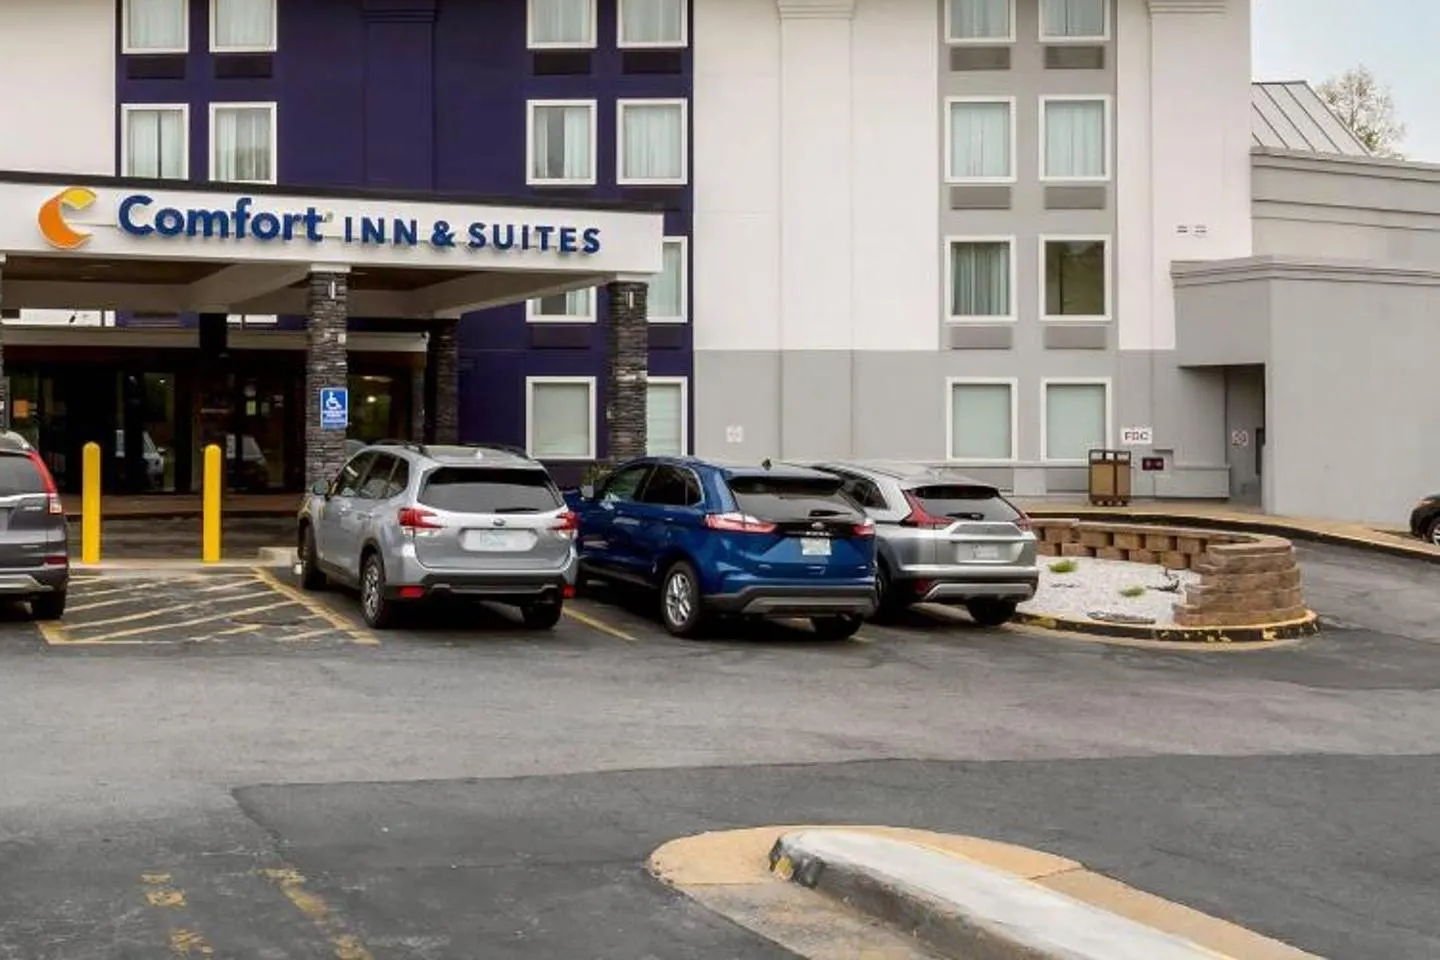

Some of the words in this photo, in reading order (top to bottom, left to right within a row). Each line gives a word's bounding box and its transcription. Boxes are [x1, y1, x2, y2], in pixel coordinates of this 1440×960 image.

[118, 194, 324, 242] Comfort
[344, 216, 418, 246] INN
[431, 220, 457, 248] &
[467, 222, 601, 254] SUITES
